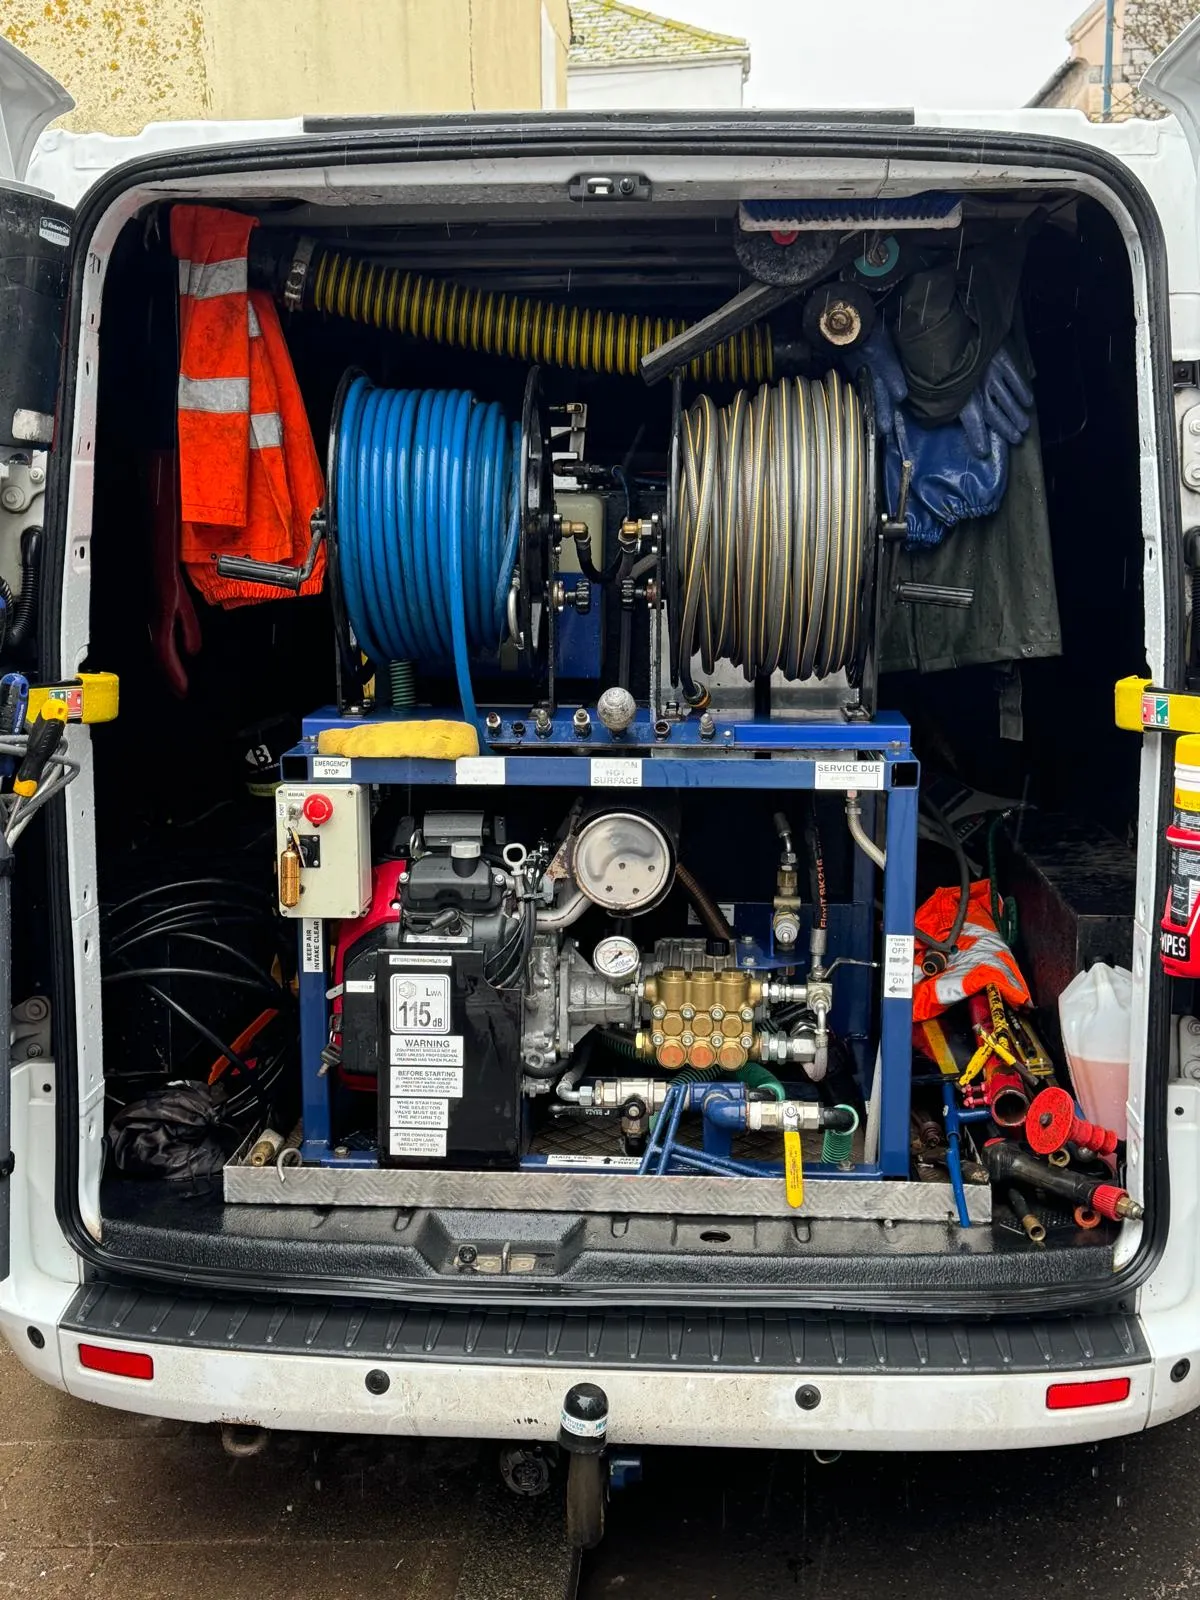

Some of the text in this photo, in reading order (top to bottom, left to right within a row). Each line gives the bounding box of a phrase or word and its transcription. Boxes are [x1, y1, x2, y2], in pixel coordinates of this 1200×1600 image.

[818, 764, 858, 772] SERVICE
[399, 1001, 431, 1027] 115
[432, 1018, 442, 1027] dB
[405, 1039, 450, 1048] WARNING
